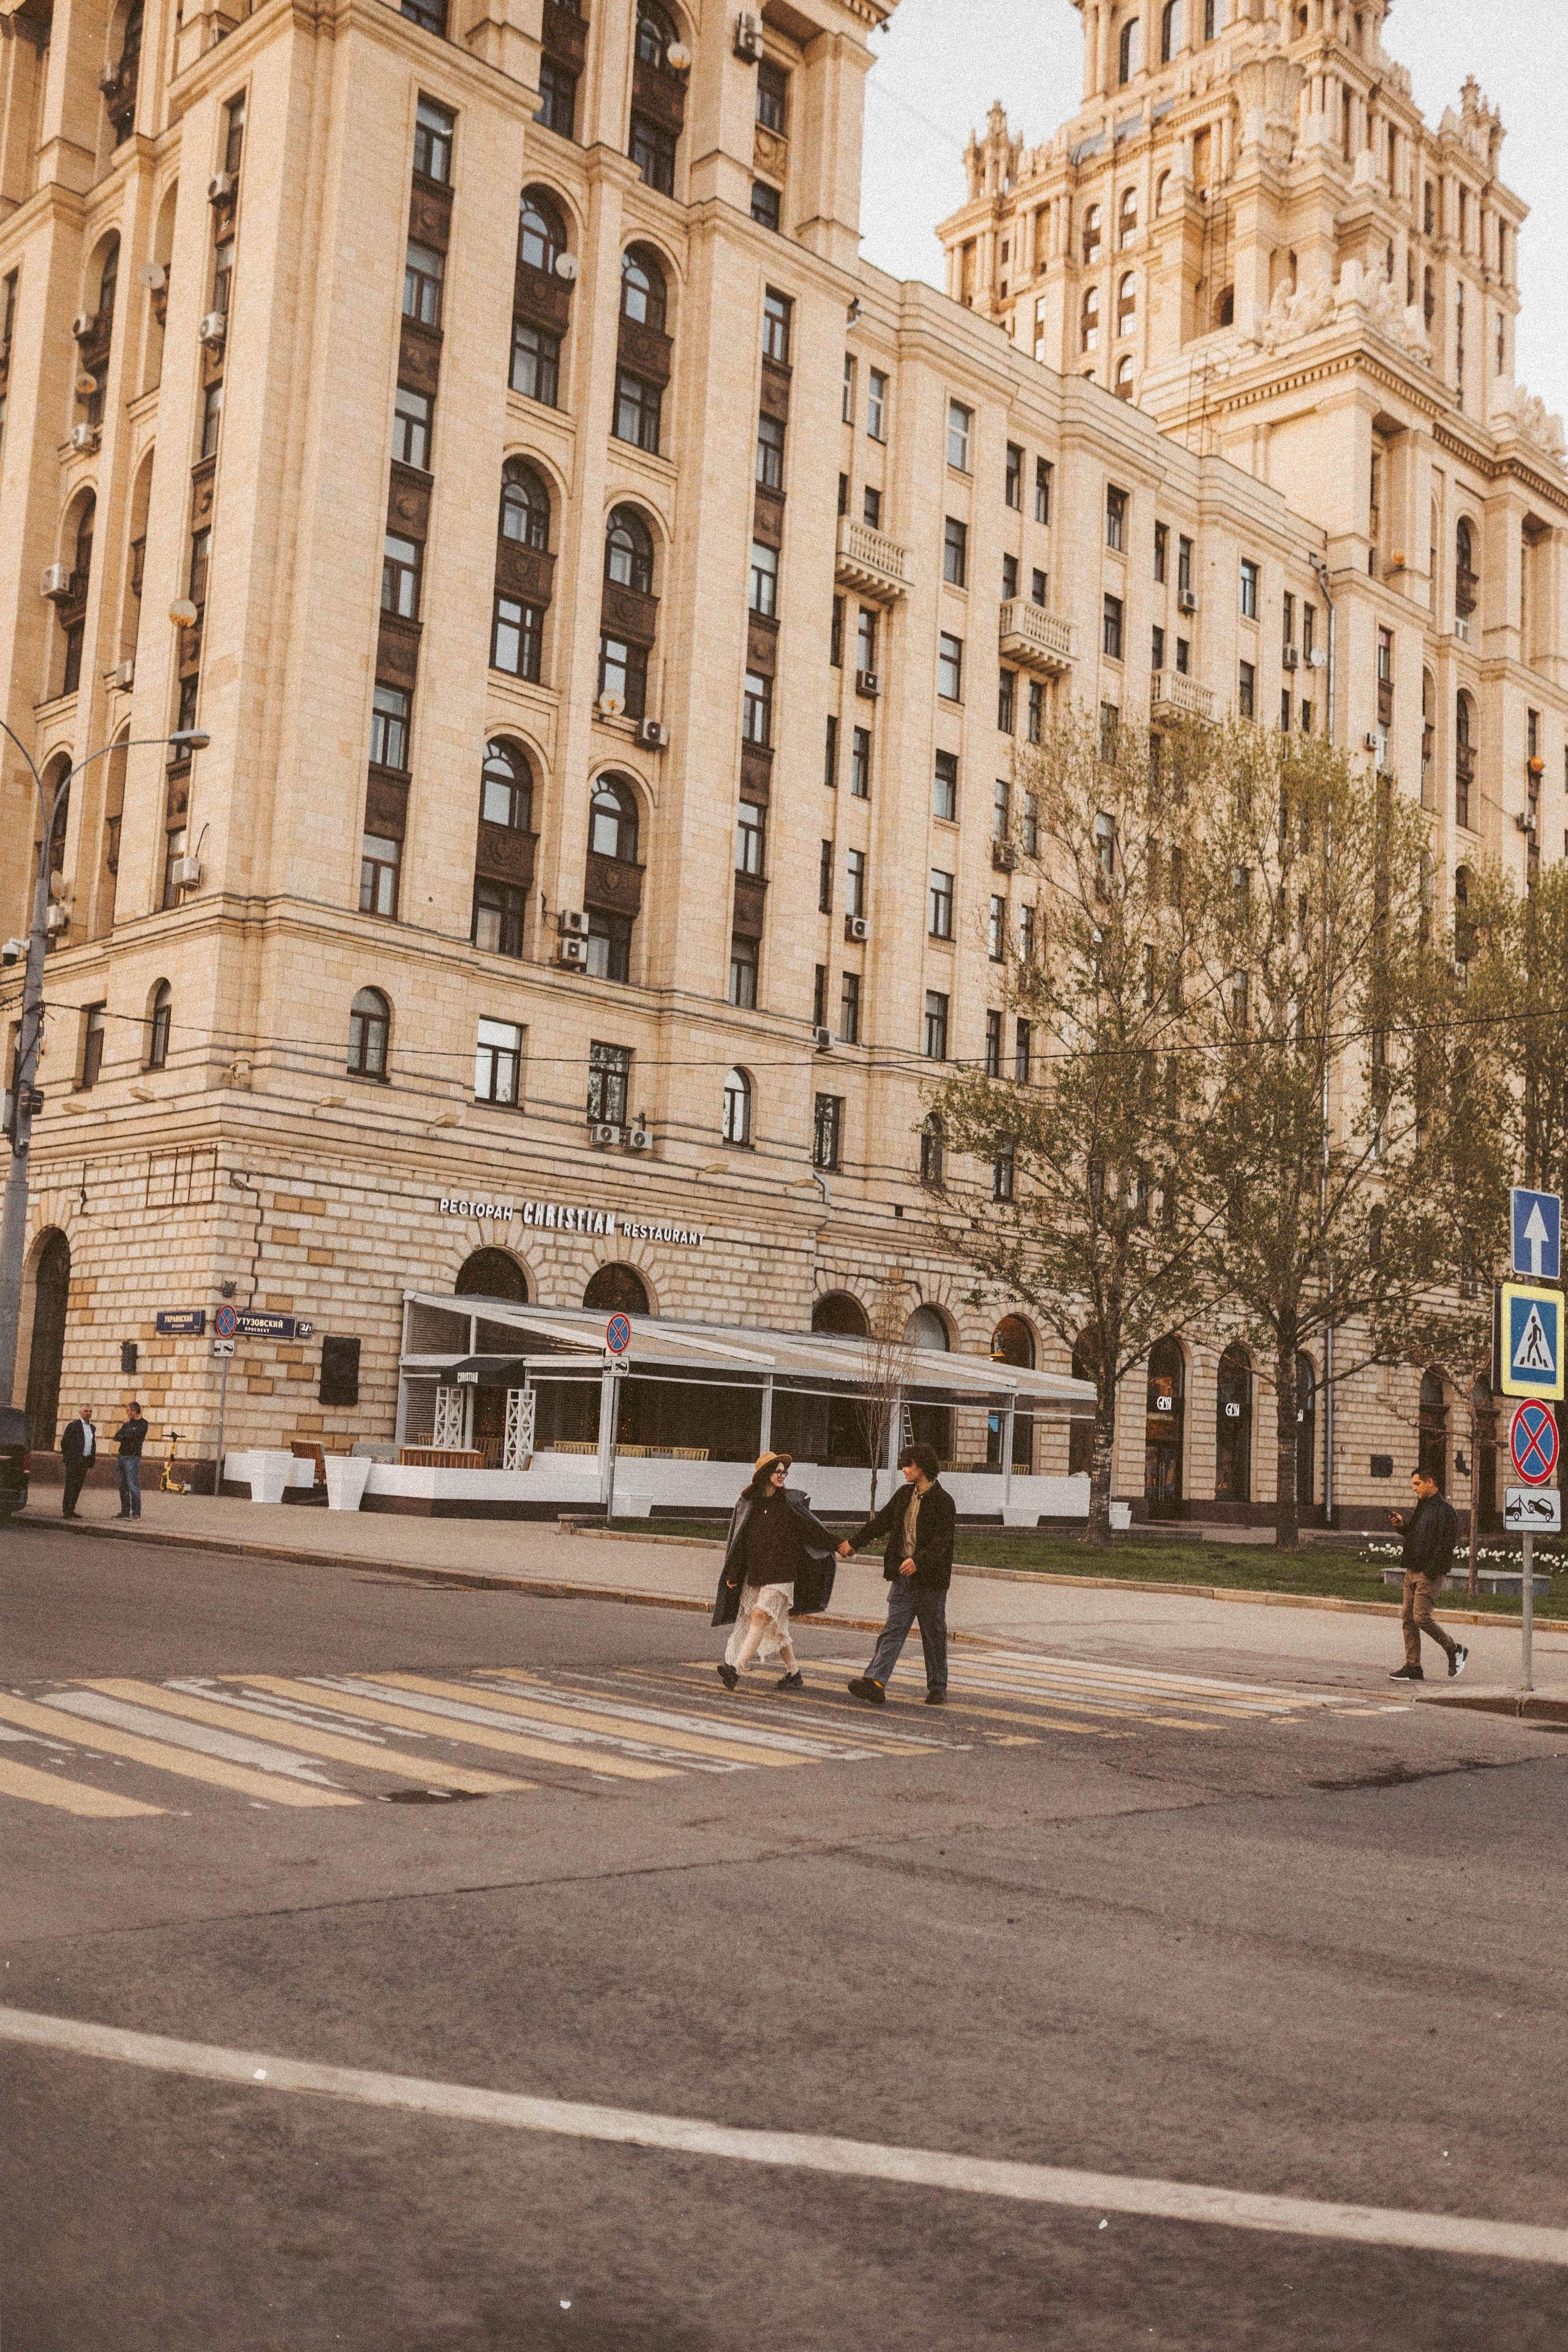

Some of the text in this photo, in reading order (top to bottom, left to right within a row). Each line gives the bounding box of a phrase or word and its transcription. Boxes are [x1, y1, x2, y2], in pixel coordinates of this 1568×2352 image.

[440, 1198, 705, 1246] РЕСТОРАН CHRISTIAN RESTAURANT
[236, 1317, 283, 1329] УТУЗОВСКИЙ
